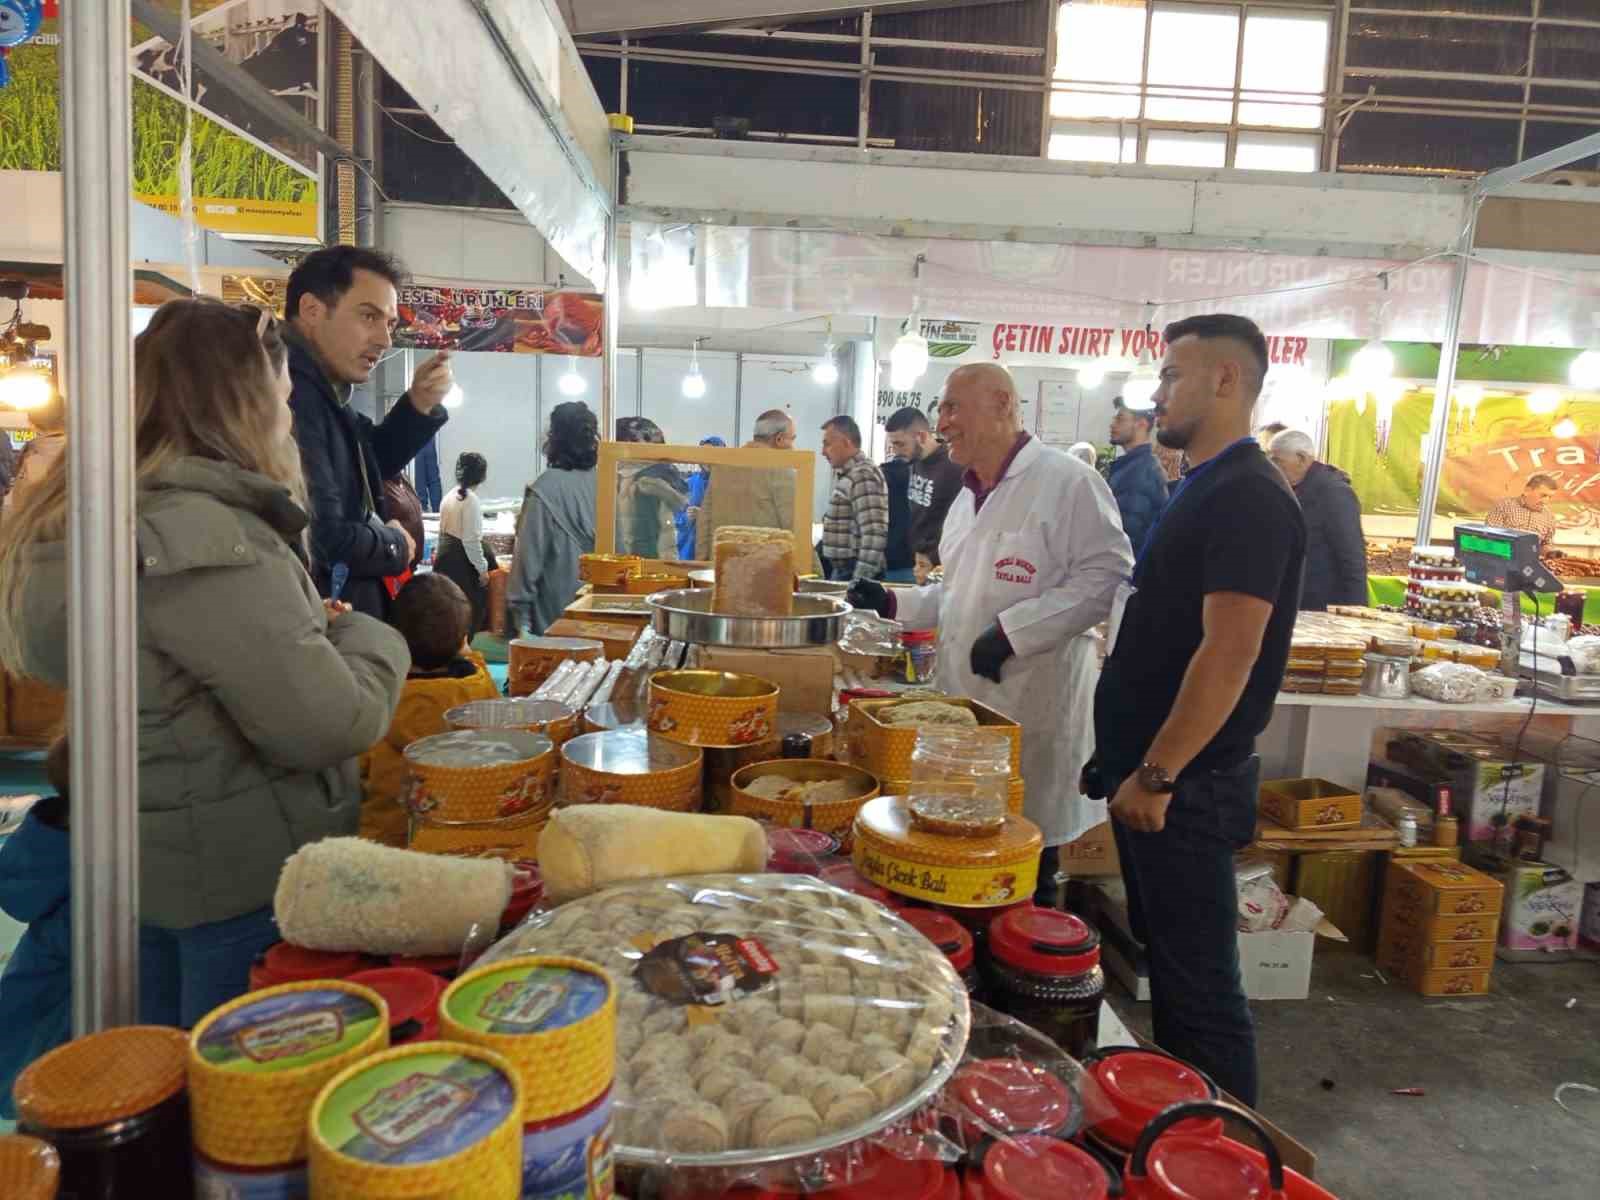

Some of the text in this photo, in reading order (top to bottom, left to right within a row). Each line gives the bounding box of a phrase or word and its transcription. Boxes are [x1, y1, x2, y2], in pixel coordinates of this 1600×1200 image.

[398, 289, 446, 305] ESEL
[1266, 335, 1308, 368] LER
[910, 391, 922, 408] 75
